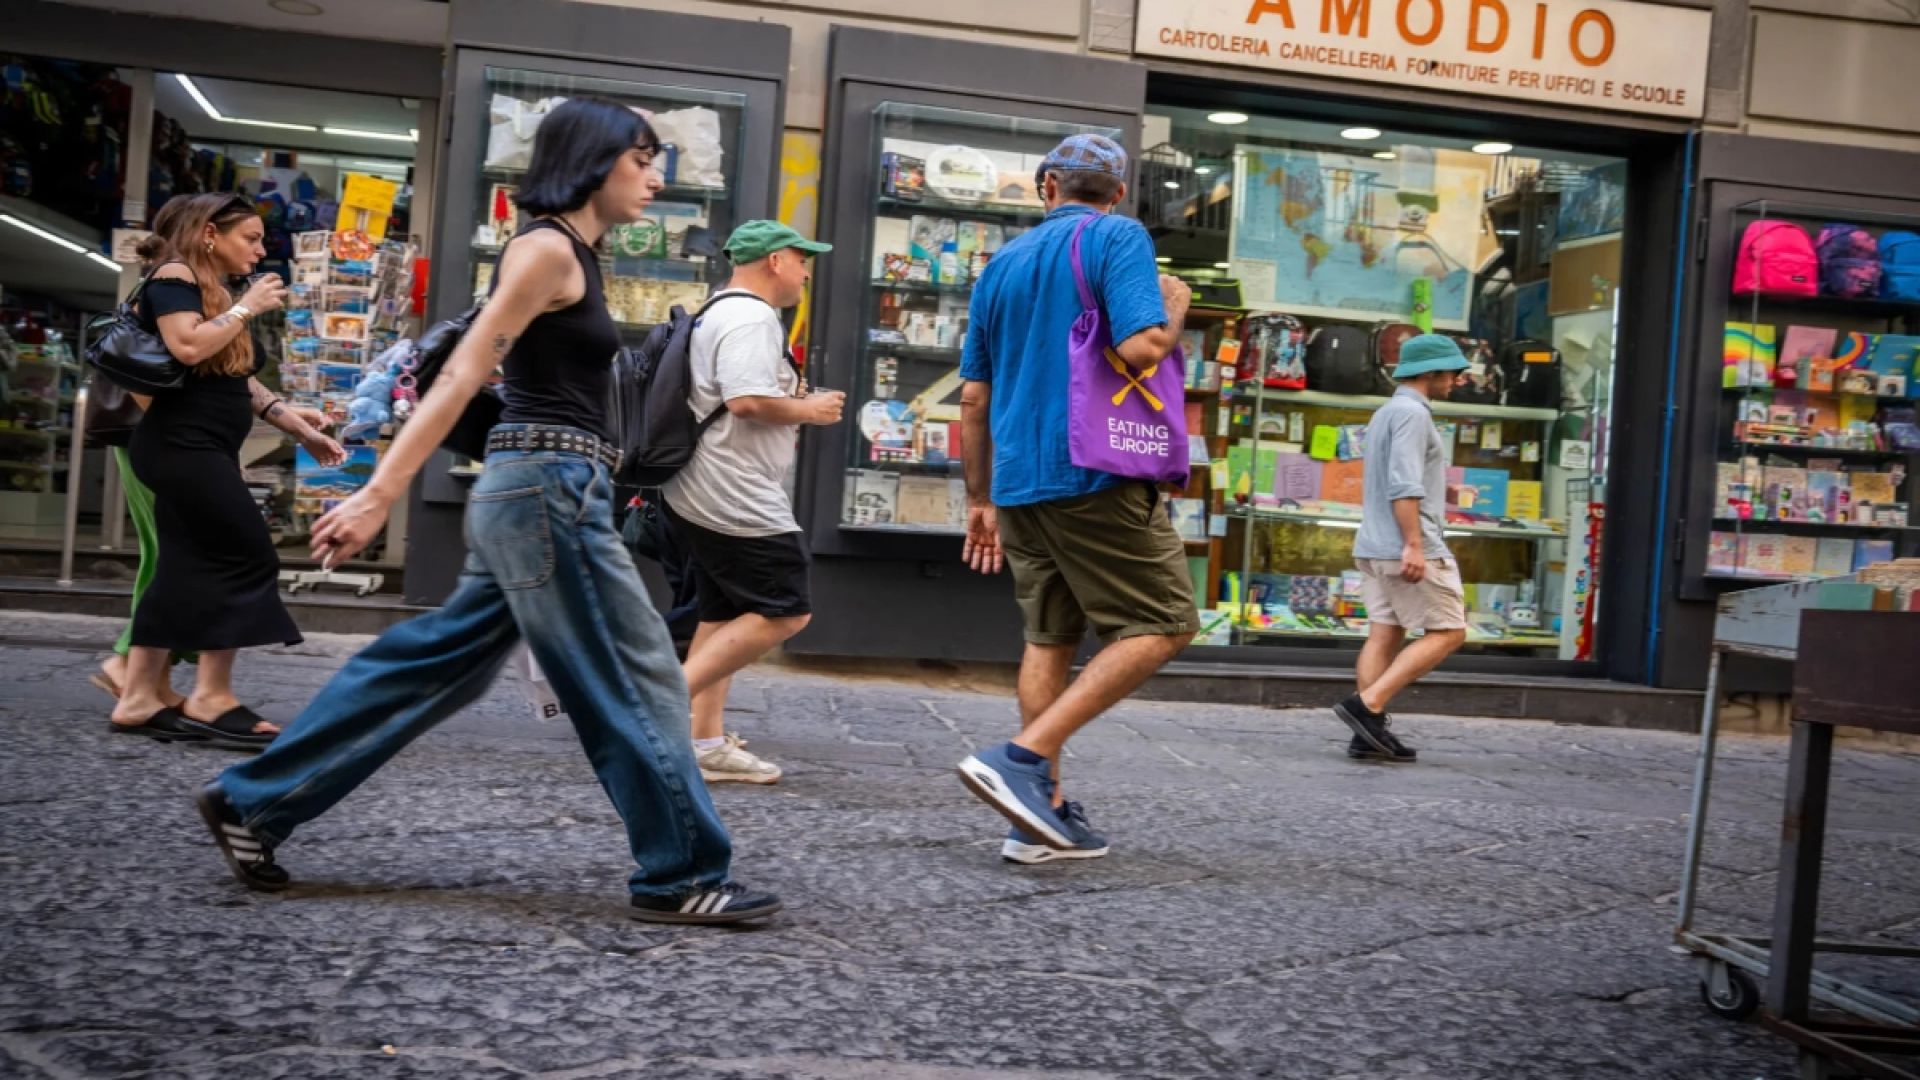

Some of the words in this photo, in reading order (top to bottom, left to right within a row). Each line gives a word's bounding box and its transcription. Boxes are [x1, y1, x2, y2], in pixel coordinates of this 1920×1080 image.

[1159, 27, 1270, 56] CARTOLERIA
[1280, 42, 1397, 72] CANCELLERIA
[1406, 57, 1499, 84] FORNITURE
[1508, 69, 1541, 89] PER
[1544, 74, 1596, 95] UFFICI
[1603, 81, 1614, 97] E
[1621, 83, 1686, 106] SCUOLE
[1107, 417, 1169, 439] EATING
[1109, 434, 1169, 457] EUROPE
